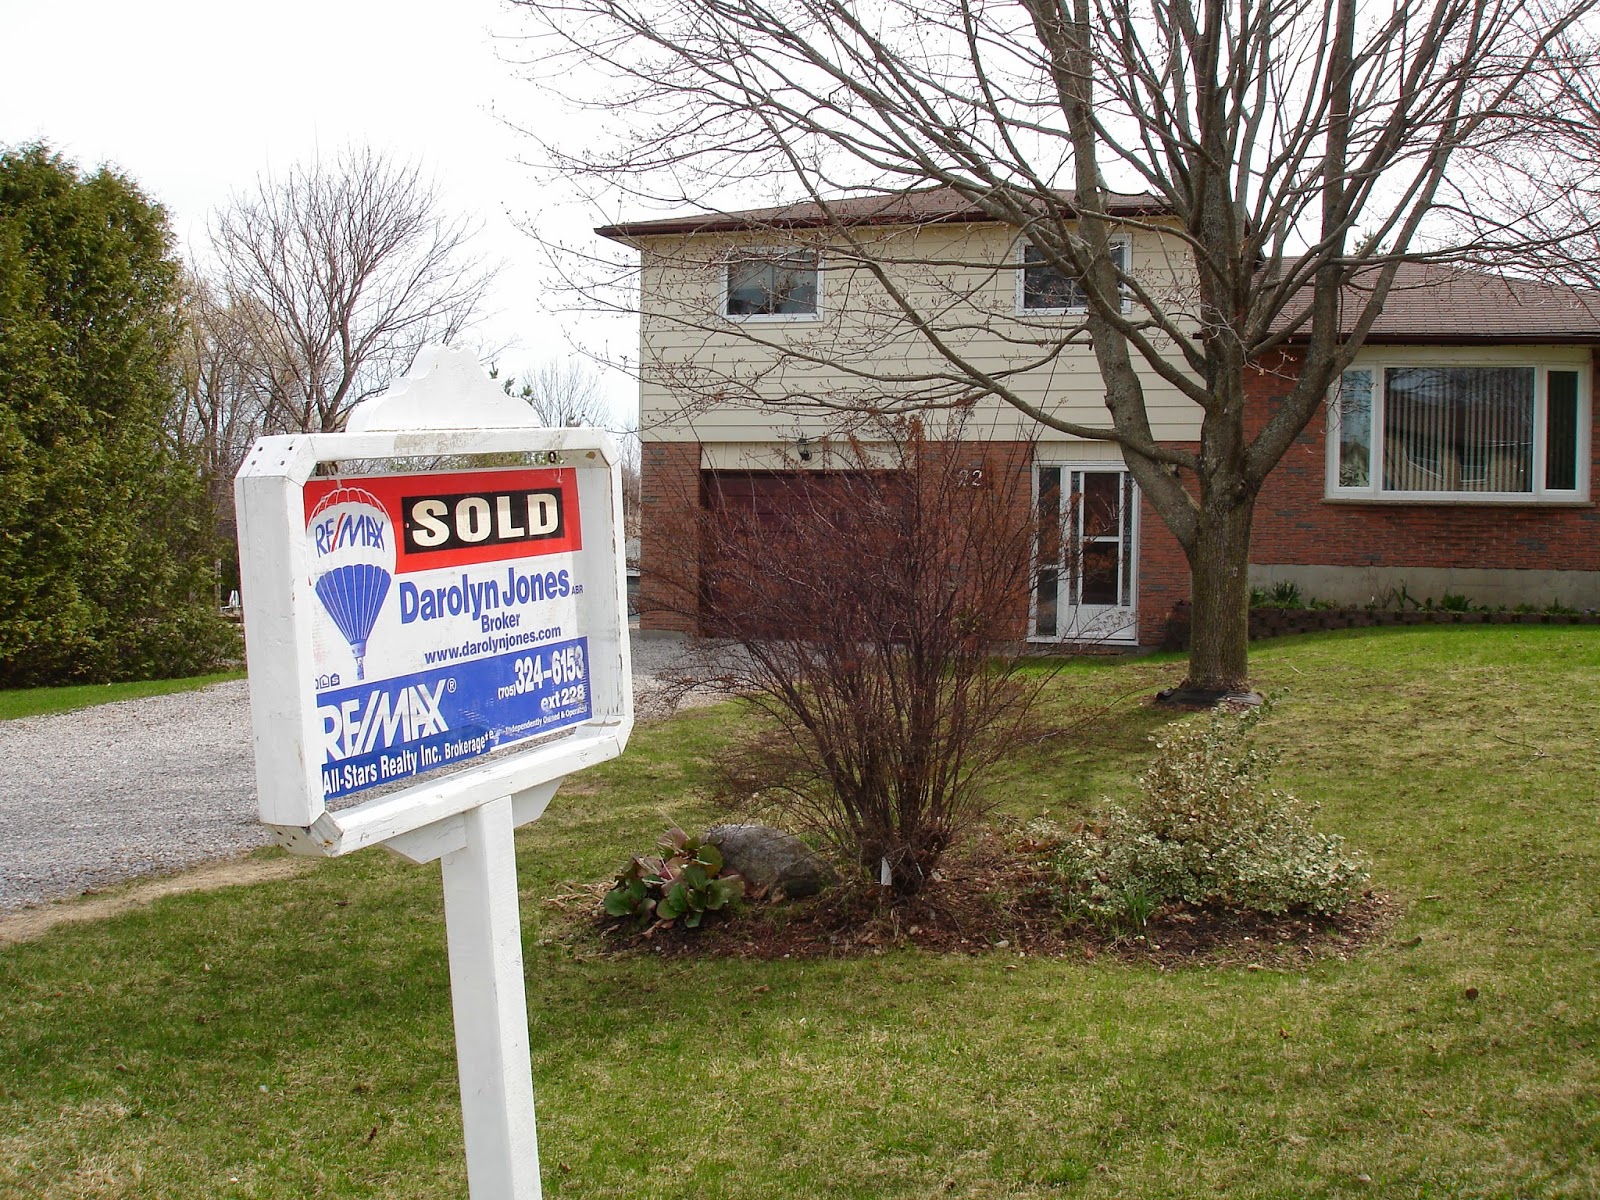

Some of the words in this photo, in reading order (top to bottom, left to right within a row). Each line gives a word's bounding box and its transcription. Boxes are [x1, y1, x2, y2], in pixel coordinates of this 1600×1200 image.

[315, 513, 385, 558] RE/MAX
[411, 493, 560, 548] SOLD
[399, 574, 500, 624] Darolyn
[502, 567, 570, 607] Jones
[481, 612, 521, 633] Broker
[425, 626, 562, 665] www.darolynjones.com
[498, 685, 517, 700] (705)
[514, 645, 585, 696] 324-6153
[317, 679, 449, 765] RE/MAX
[540, 692, 561, 712] ext
[561, 684, 585, 706] 228
[322, 763, 377, 796] All-Stars
[380, 745, 418, 779] Realty
[420, 742, 442, 768] Inc.
